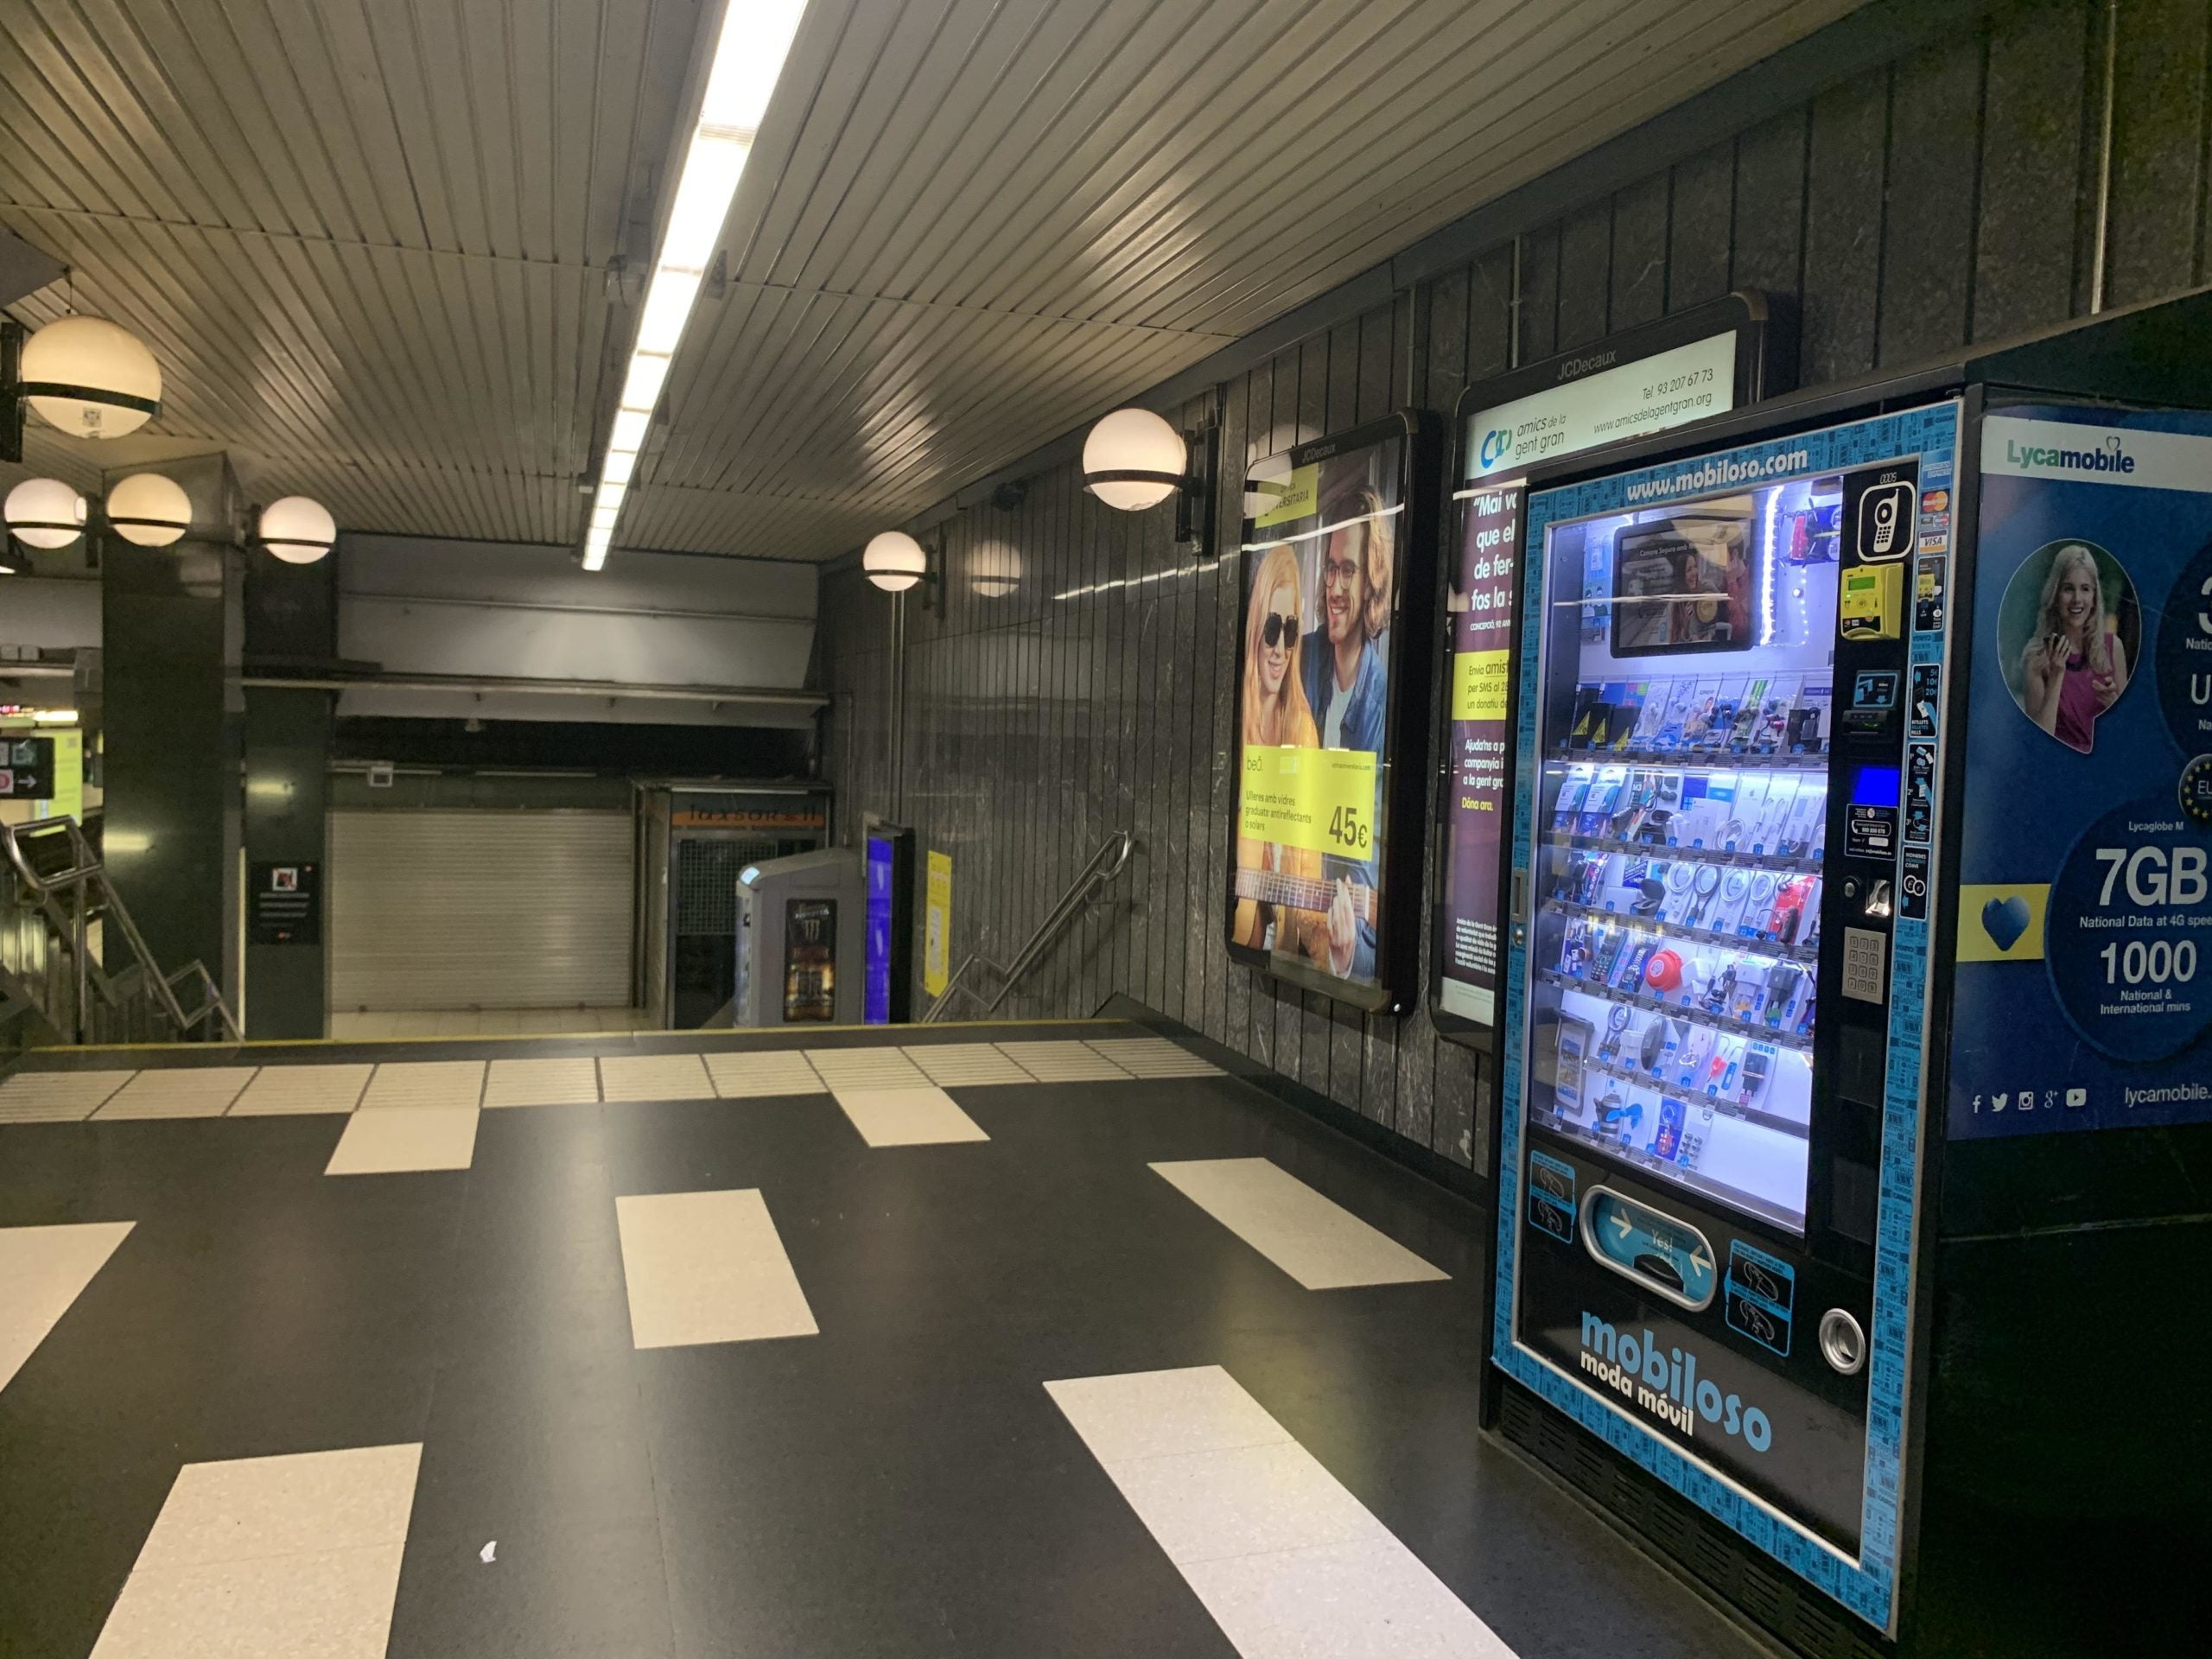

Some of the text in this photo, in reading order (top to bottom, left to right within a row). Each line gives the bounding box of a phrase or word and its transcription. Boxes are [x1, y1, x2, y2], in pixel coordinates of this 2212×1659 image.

[1558, 350, 1616, 380] JCDecaux
[1658, 382, 1668, 396] 93
[1669, 376, 1686, 392] 207
[1688, 372, 1699, 386] 67
[1701, 368, 1713, 382] 73
[1593, 393, 1712, 434] www.amicsdelagentgran.org
[1516, 414, 1567, 436] amics de la
[1302, 443, 1336, 463] JCDecaux
[1516, 430, 1564, 460] gent gran
[2007, 439, 2135, 474] Lycamobile
[1627, 449, 1808, 501] www.mobiloso.com
[1476, 518, 1516, 553] que el
[1924, 535, 1942, 547] VISA
[1474, 557, 1490, 580] de
[1494, 586, 1505, 607] la
[1469, 664, 1484, 676] Envia
[1468, 684, 1478, 696] per
[1479, 683, 1492, 692] SMS
[1493, 681, 1500, 691] al
[1476, 698, 1498, 709] donatiu
[1465, 757, 1499, 772] companyia
[1468, 774, 1475, 787] la
[1476, 775, 1491, 789] gent
[1265, 792, 1277, 804] amb
[1278, 794, 1295, 806] vidres
[1249, 820, 1265, 831] solars
[1329, 806, 1368, 849] 45€
[2128, 821, 2183, 833] Lycaglobe M
[2096, 846, 2208, 906] 7GB
[2080, 915, 2125, 928] National
[2128, 915, 2153, 927] Data
[2156, 916, 2168, 926] at
[2170, 914, 2184, 926] 4G
[2101, 940, 2196, 984] 1000
[2120, 988, 2171, 1001] National &
[2101, 1001, 2191, 1015] International mins
[1652, 1229, 1673, 1253] Yes!
[1580, 1310, 1771, 1452] mobiloso
[1580, 1351, 1694, 1437] moda móvil
